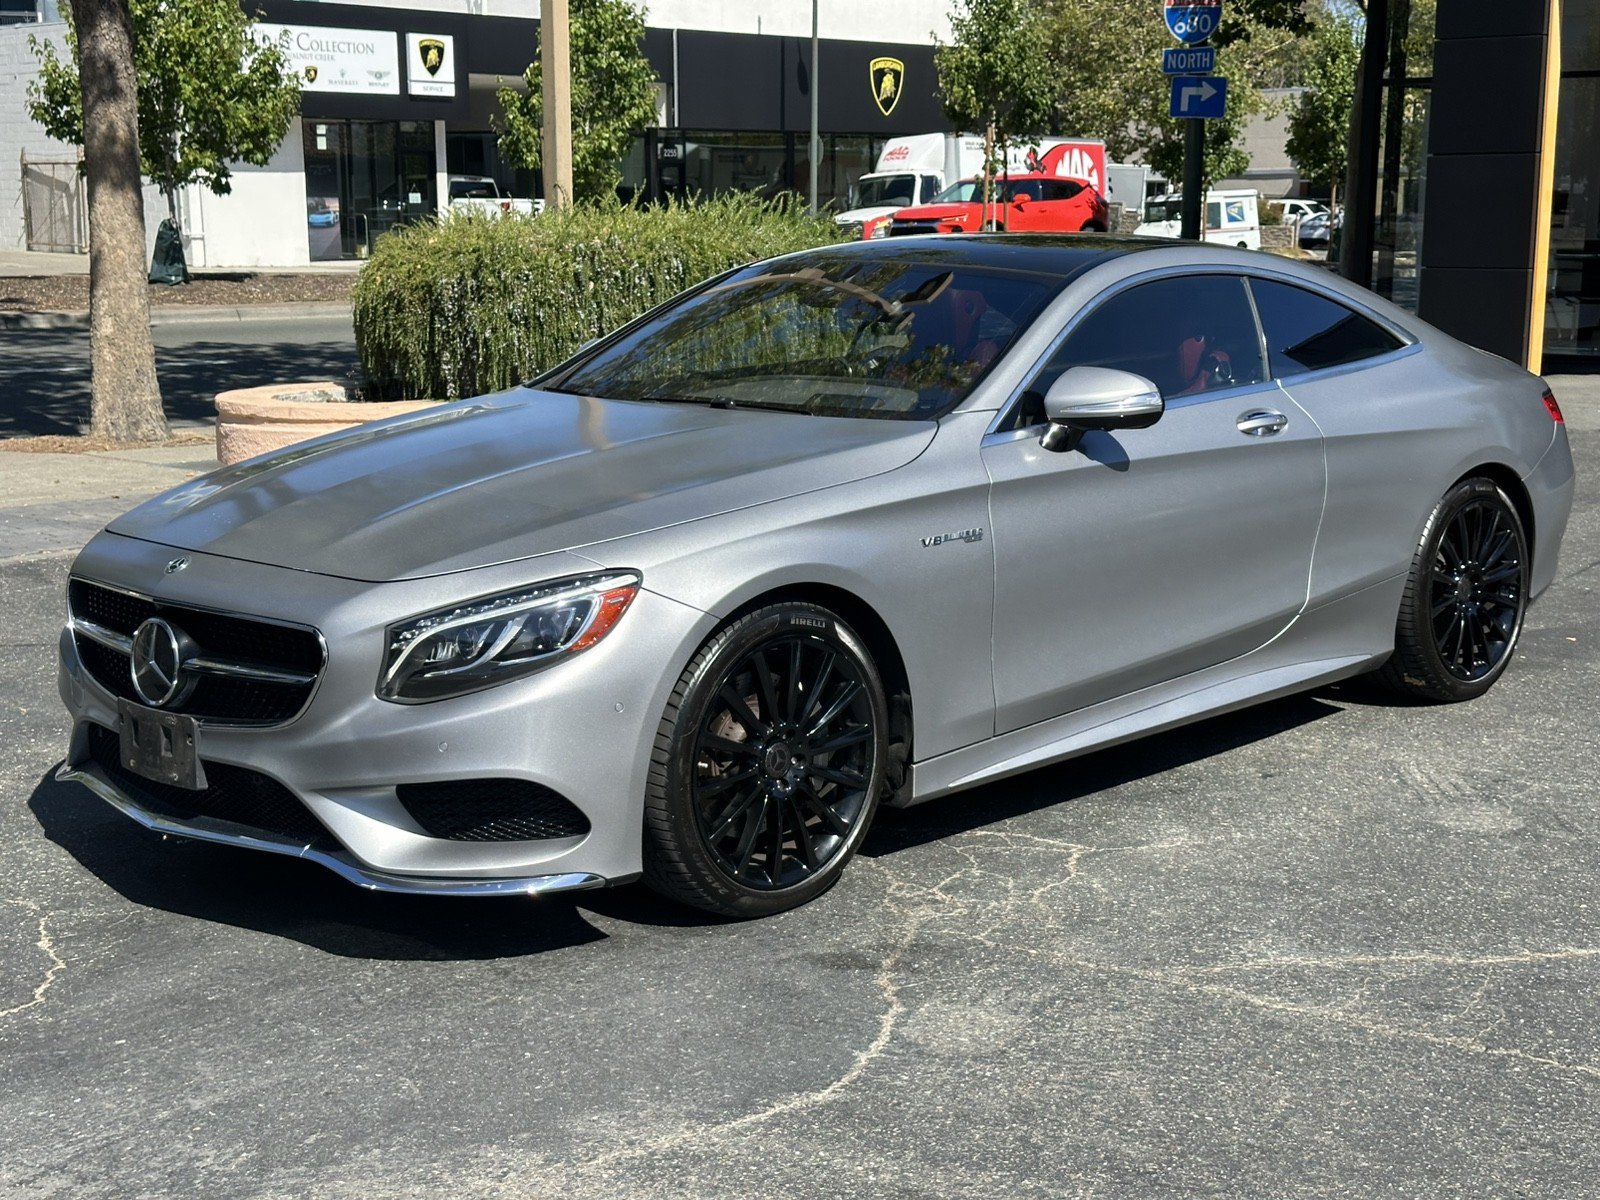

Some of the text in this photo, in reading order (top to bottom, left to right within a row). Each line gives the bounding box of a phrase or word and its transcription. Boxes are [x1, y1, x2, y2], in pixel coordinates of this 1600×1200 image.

[1174, 15, 1211, 34] 680
[1167, 52, 1211, 69] NORTH
[663, 148, 677, 157] 2255
[790, 617, 826, 628] PIRELLI
